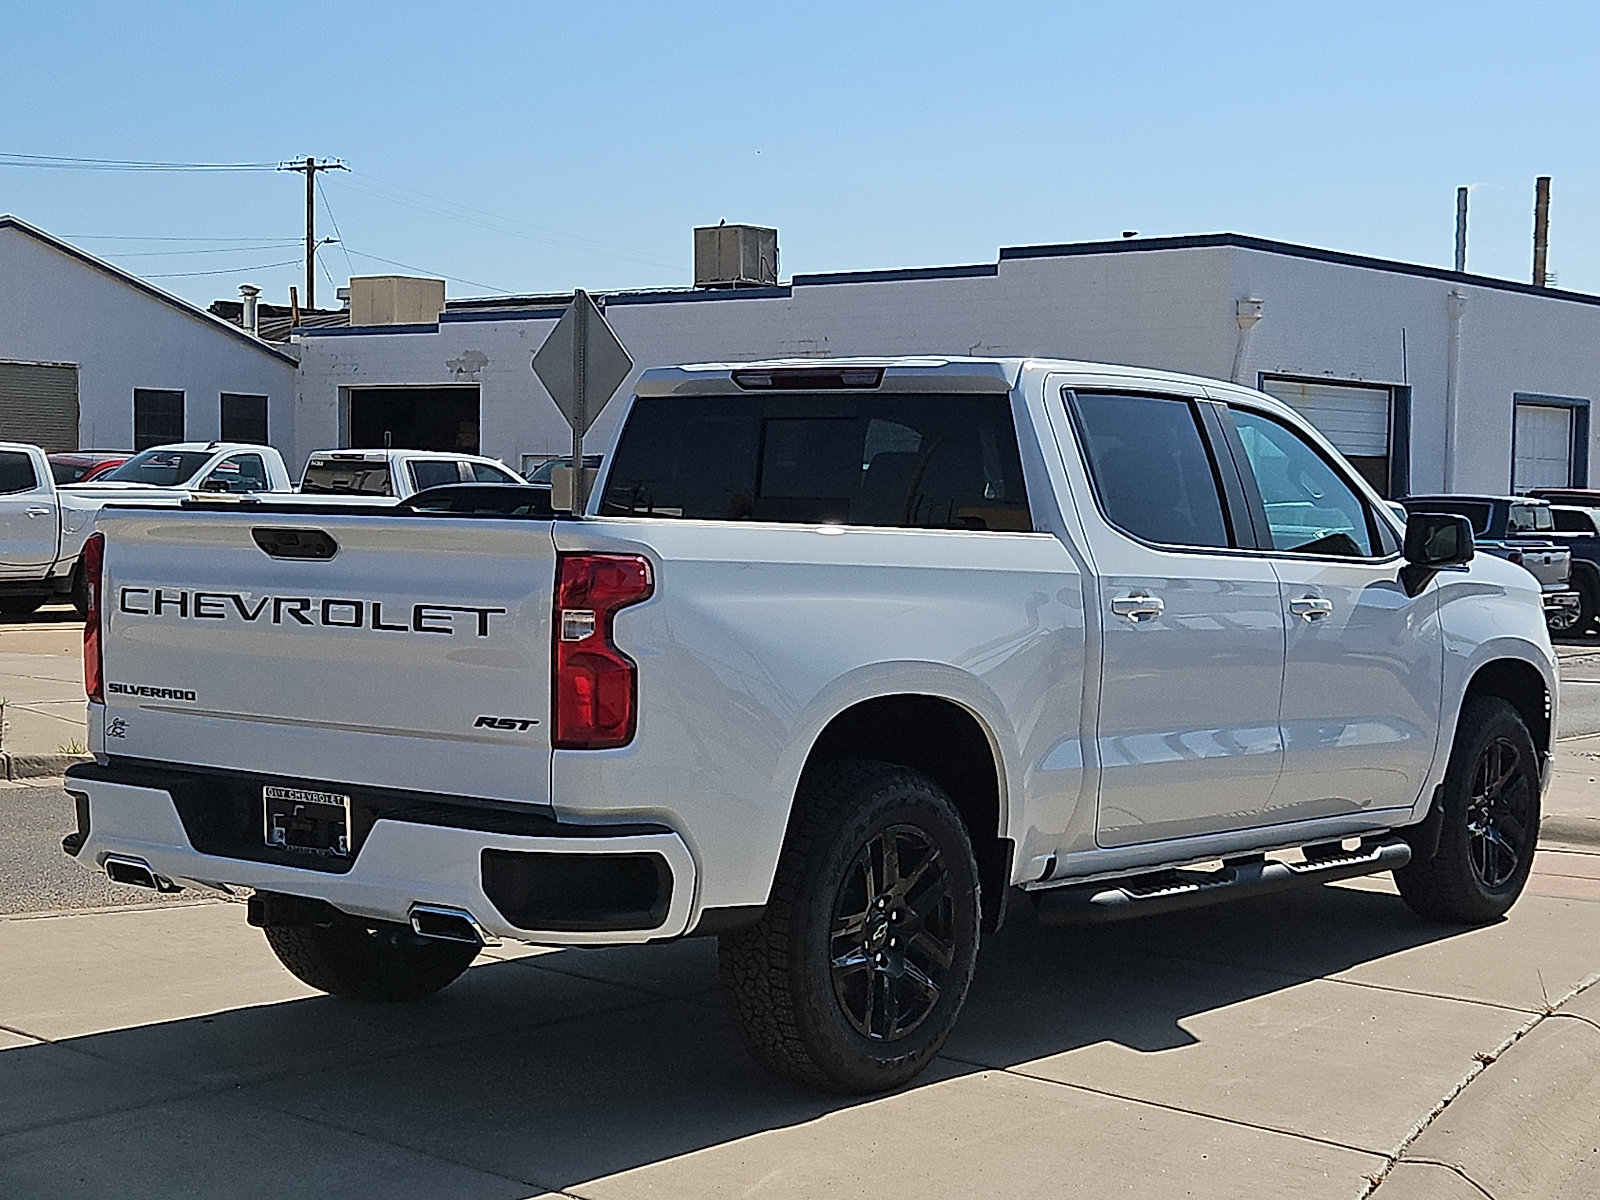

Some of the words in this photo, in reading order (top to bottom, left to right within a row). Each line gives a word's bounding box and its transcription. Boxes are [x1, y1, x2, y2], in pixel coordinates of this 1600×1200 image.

[120, 587, 506, 637] CHEVROLET
[108, 683, 196, 701] SILVERADO
[473, 716, 540, 731] RST
[288, 790, 341, 804] CHEVROLET
